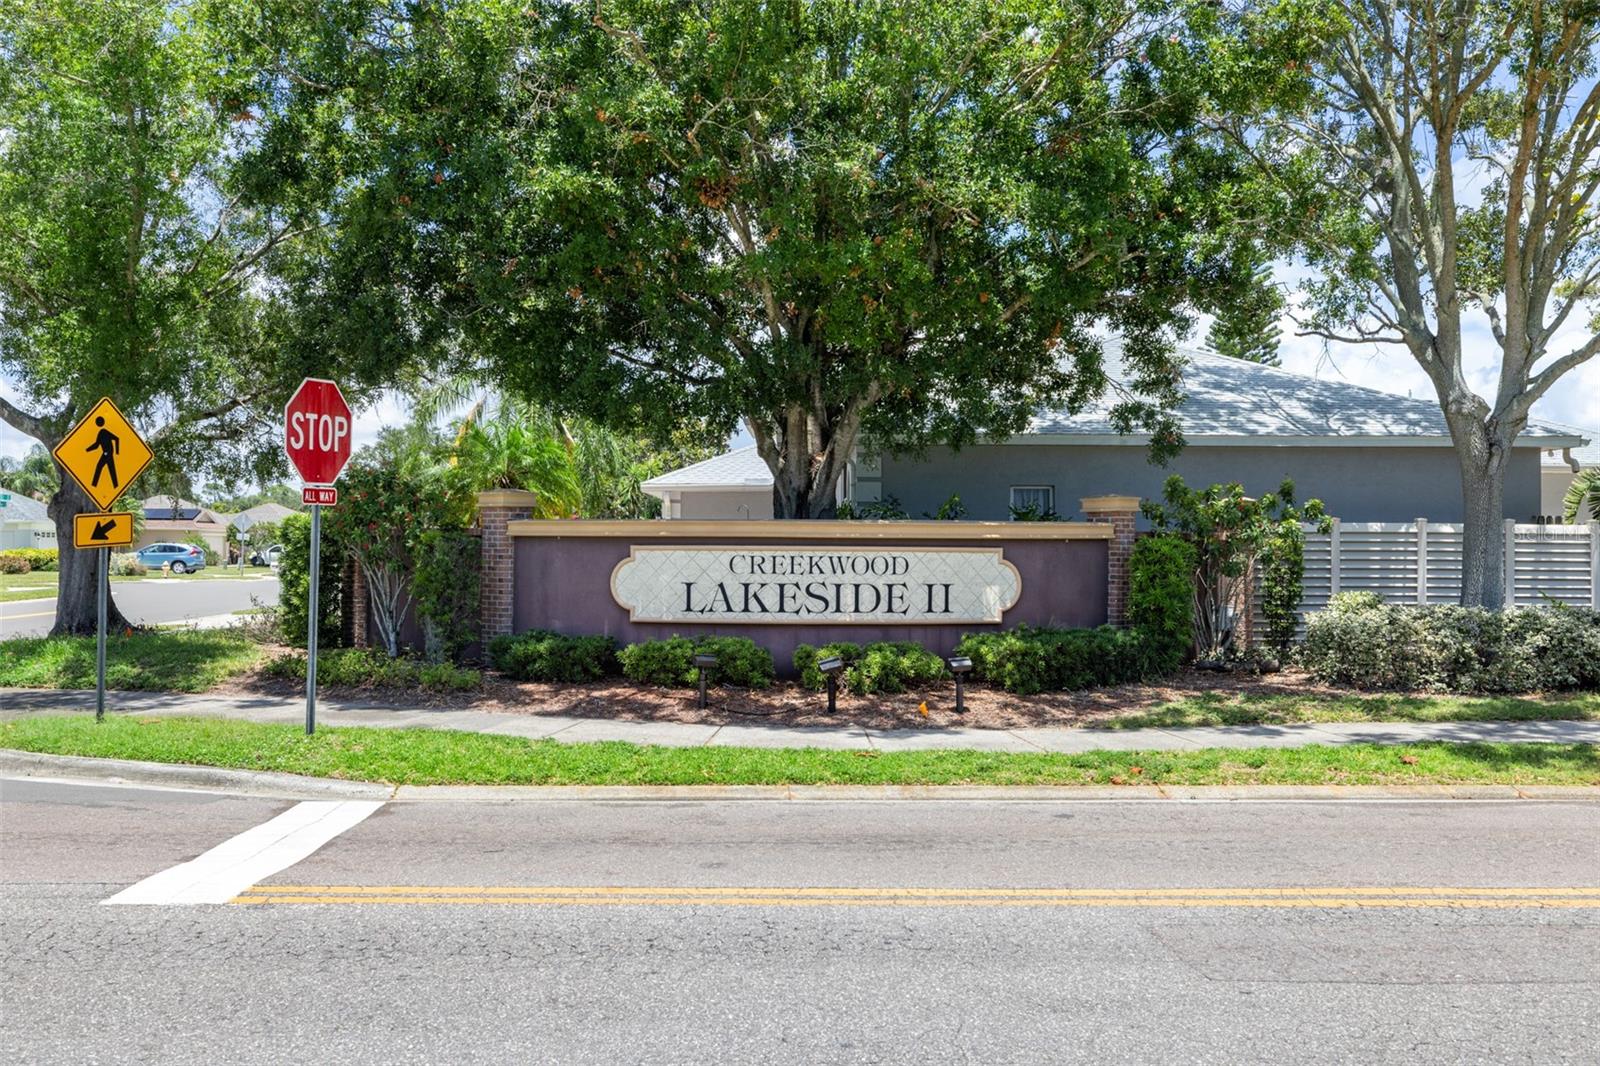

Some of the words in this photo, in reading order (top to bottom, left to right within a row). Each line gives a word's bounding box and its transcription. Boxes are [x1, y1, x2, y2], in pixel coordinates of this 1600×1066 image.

[290, 411, 348, 452] STOP
[304, 491, 316, 501] ALL
[319, 491, 334, 502] WAY
[729, 554, 909, 576] CREEKWOOD
[681, 582, 910, 614] LAKESIDE
[924, 583, 954, 614] II
